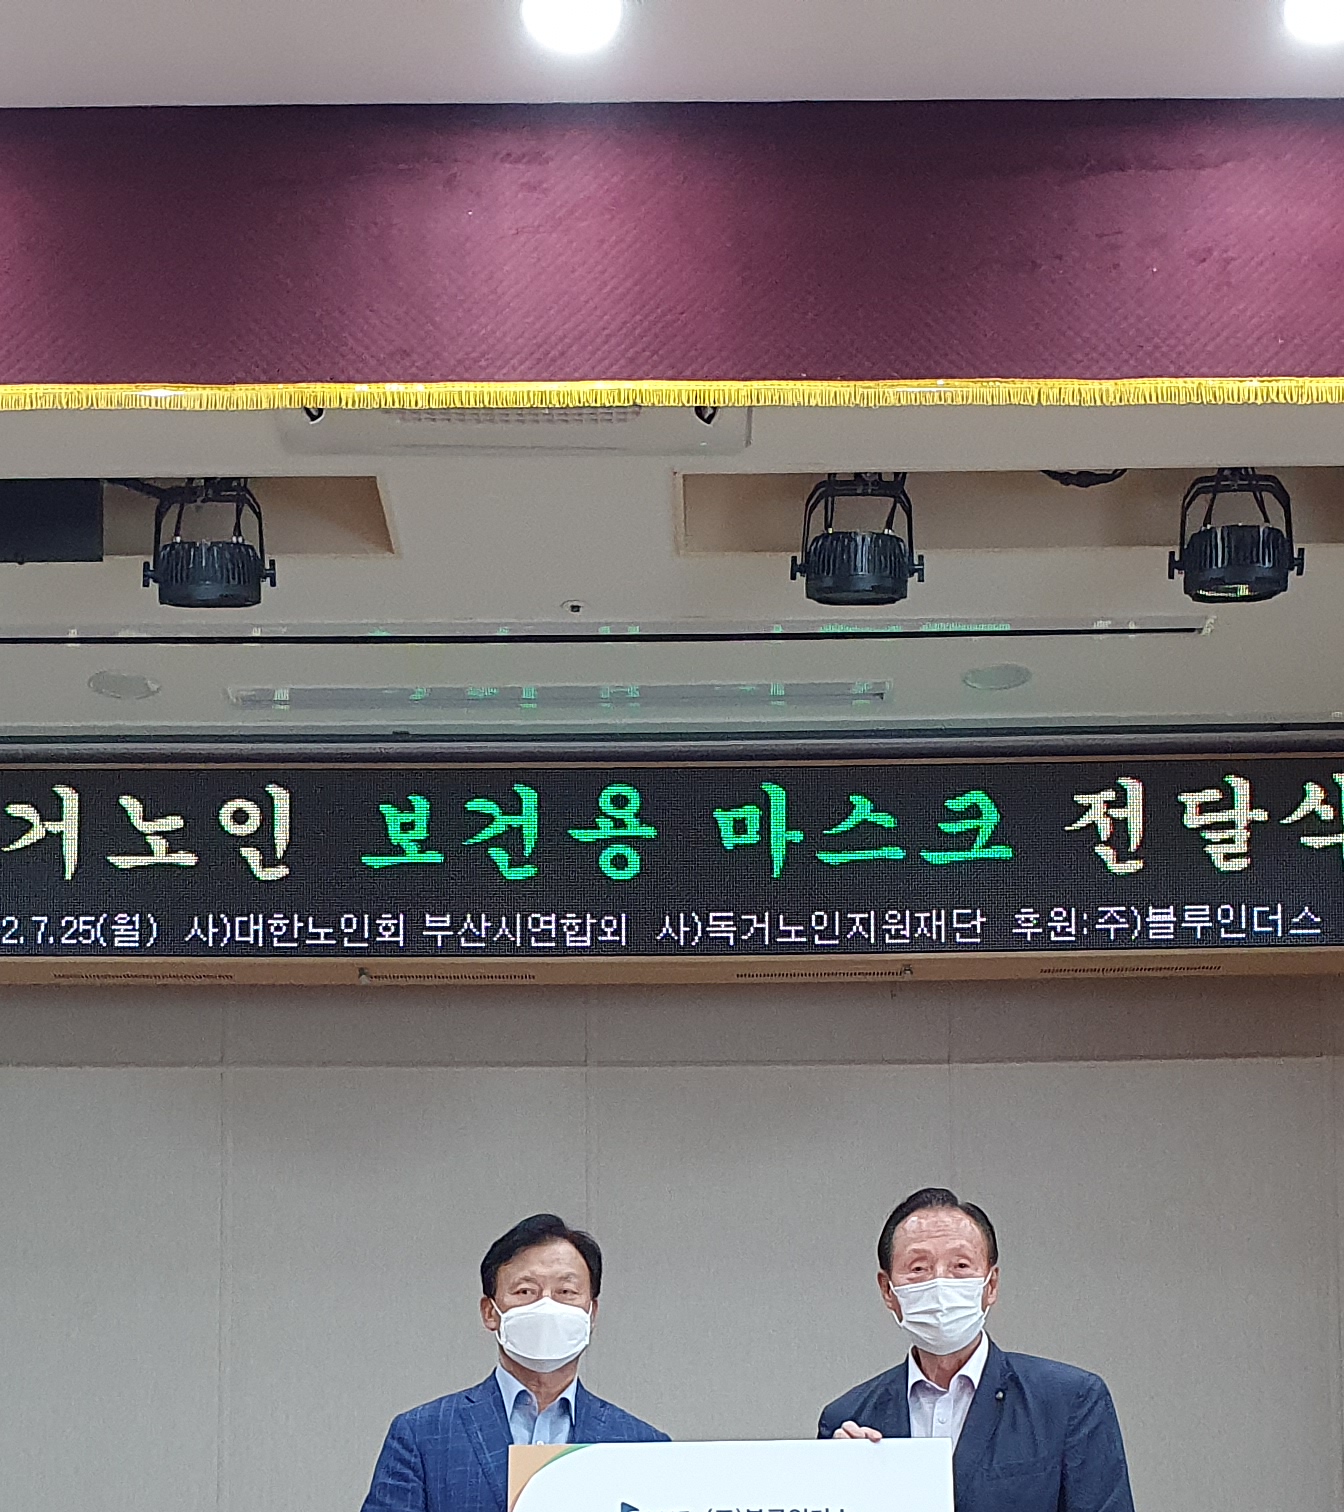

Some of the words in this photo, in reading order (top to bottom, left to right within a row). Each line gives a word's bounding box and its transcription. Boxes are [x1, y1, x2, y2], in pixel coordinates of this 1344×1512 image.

[361, 782, 658, 881] 보건용
[712, 782, 1013, 877] 마스크
[184, 913, 406, 948] 사)대한노인회
[656, 911, 985, 946] 사)독거노인지원재단
[1012, 904, 1323, 942] 후원:주)블루인더스
